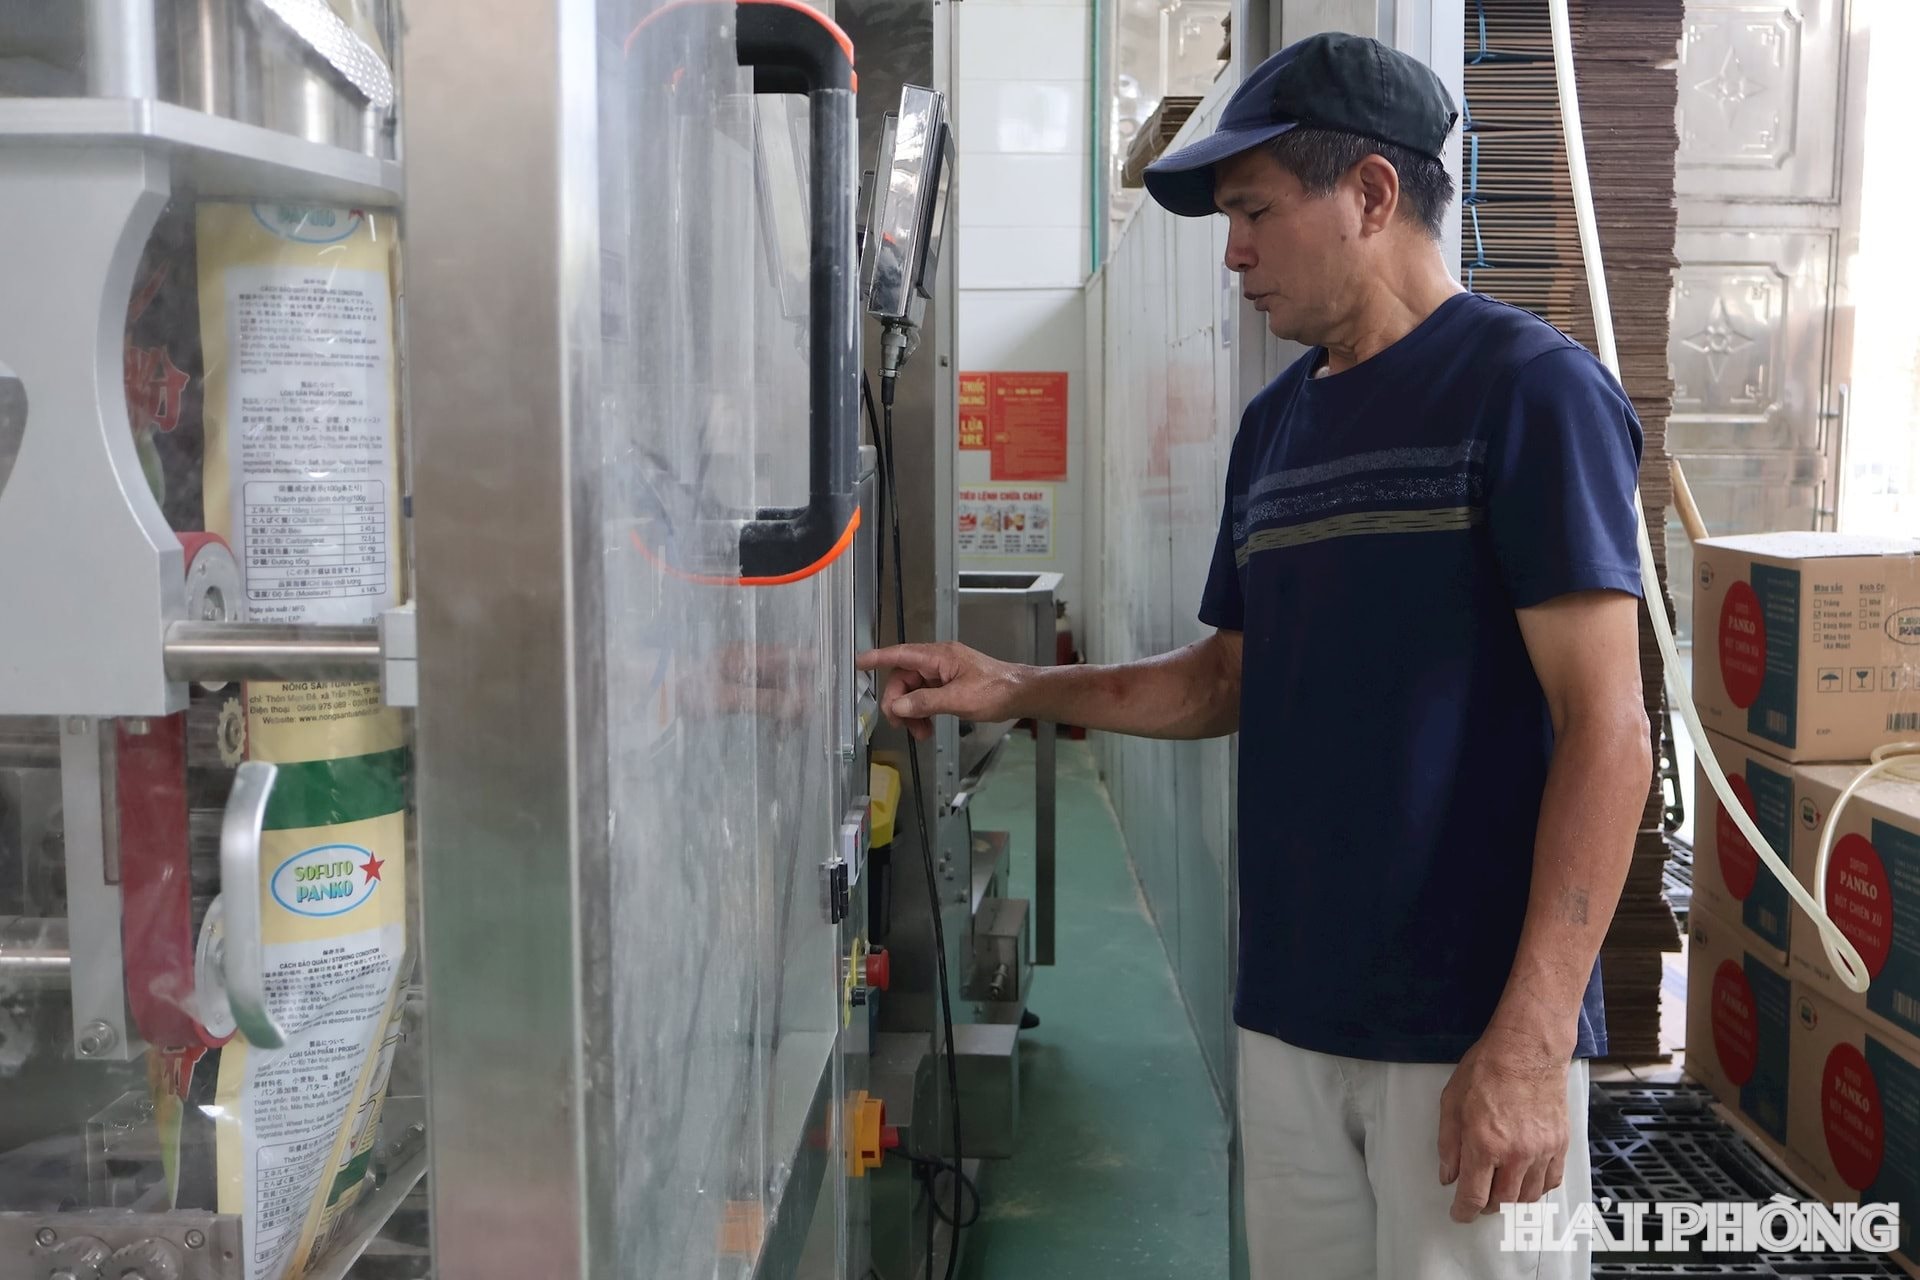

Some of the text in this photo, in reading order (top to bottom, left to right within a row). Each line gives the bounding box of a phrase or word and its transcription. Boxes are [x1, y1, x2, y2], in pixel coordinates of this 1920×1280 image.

[961, 416, 984, 431] LỬA
[1727, 615, 1757, 636] PANKO
[294, 861, 354, 882] SOFUTO
[296, 881, 354, 903] PANKO
[1840, 869, 1879, 901] PANKO
[1834, 1074, 1871, 1114] PANKO
